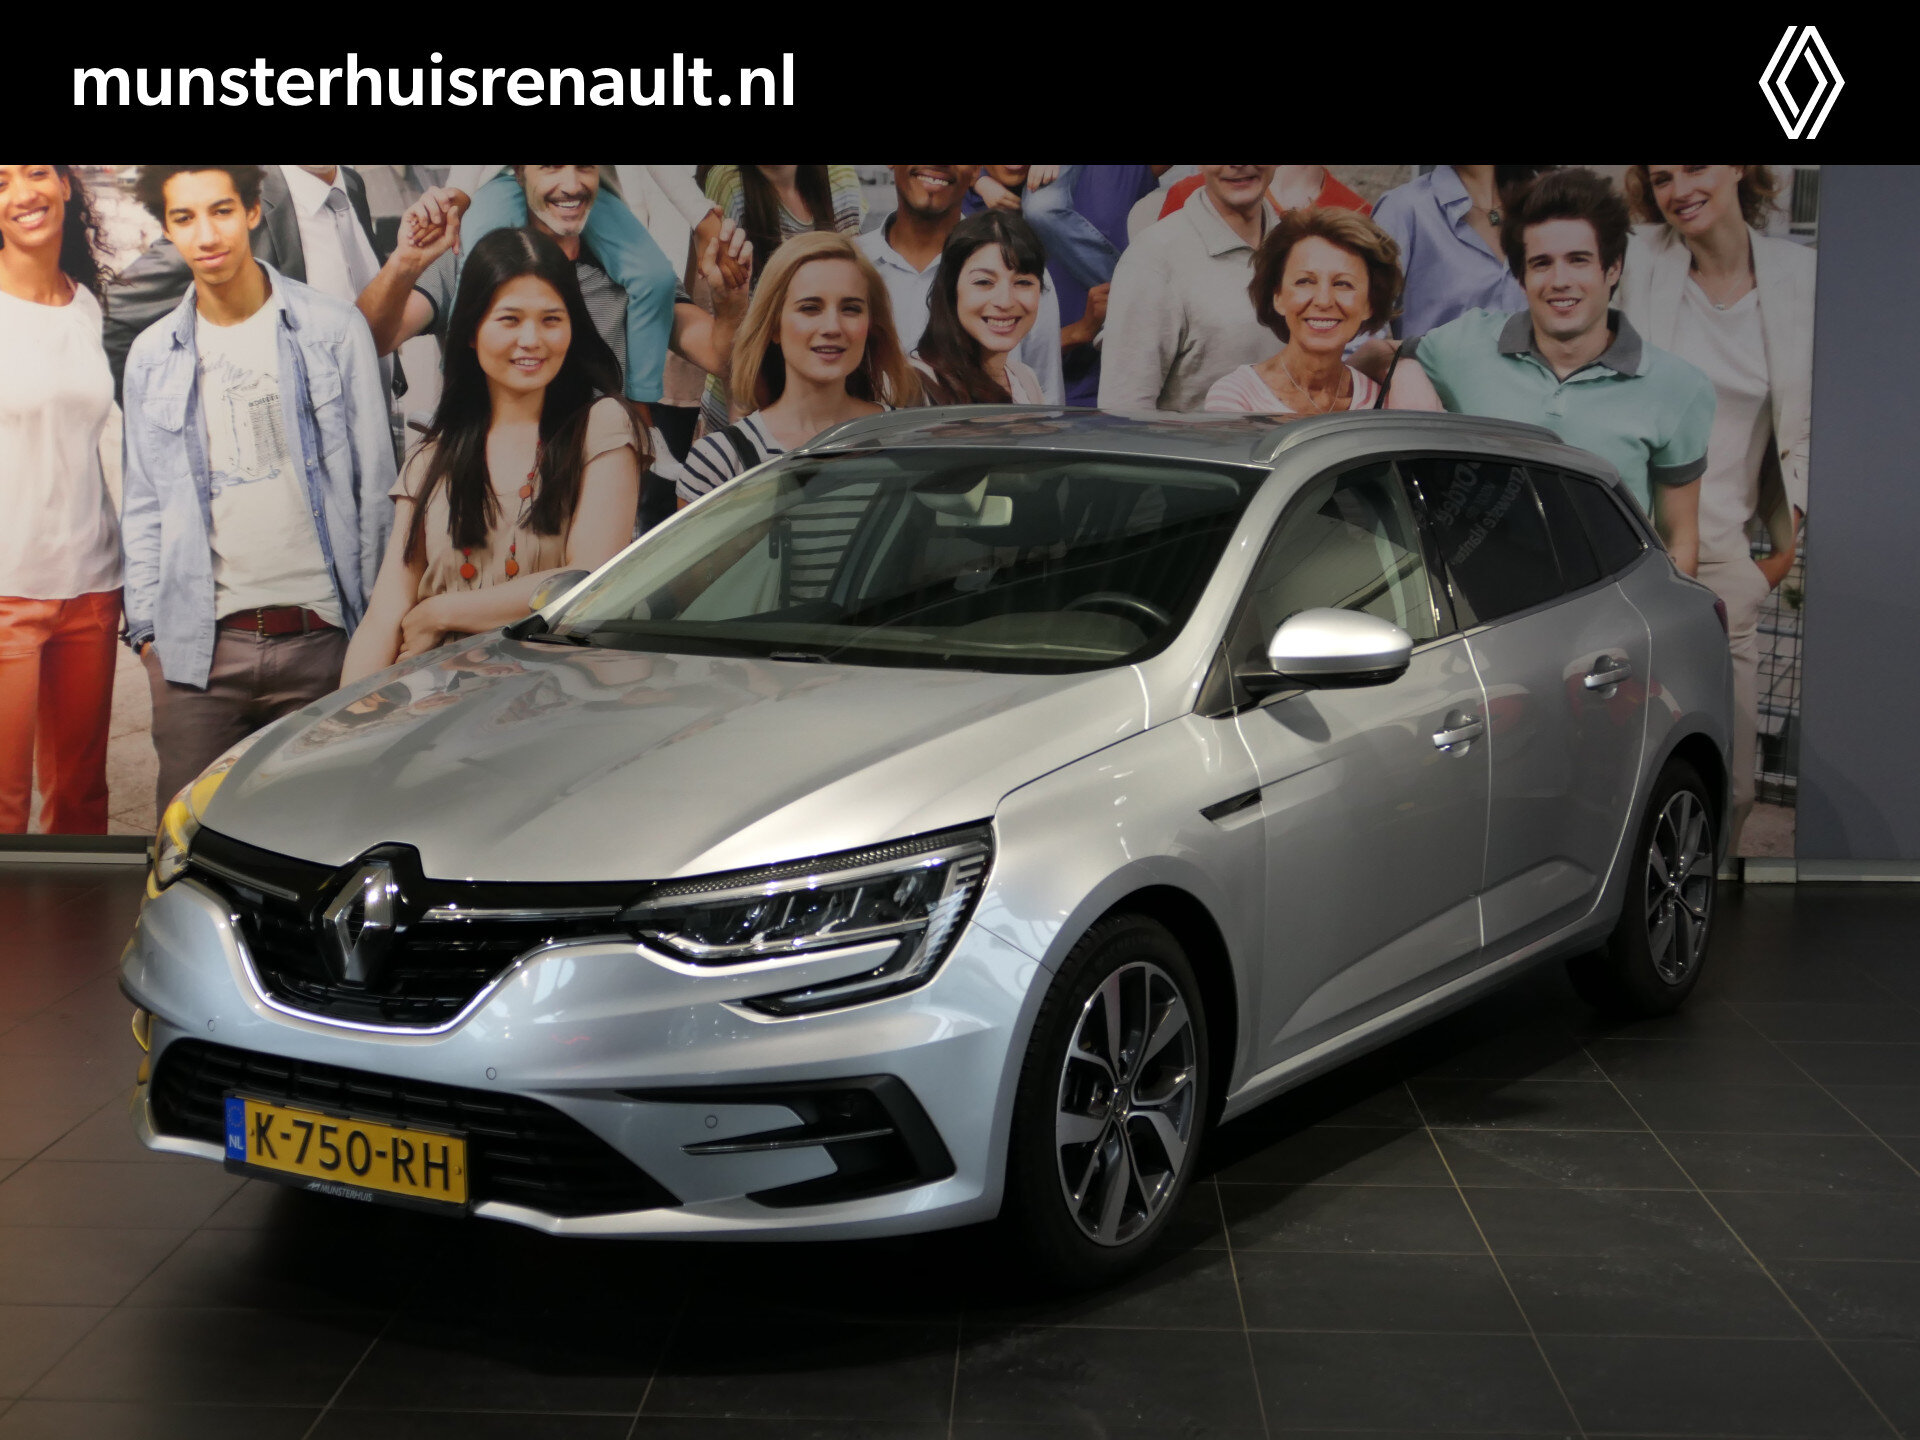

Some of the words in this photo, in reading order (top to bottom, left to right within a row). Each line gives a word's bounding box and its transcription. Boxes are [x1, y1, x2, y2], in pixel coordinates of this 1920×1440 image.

[229, 1134, 244, 1150] NL
[255, 1111, 449, 1191] K-750-RH
[320, 1184, 373, 1202] MUNSTERHUIS
